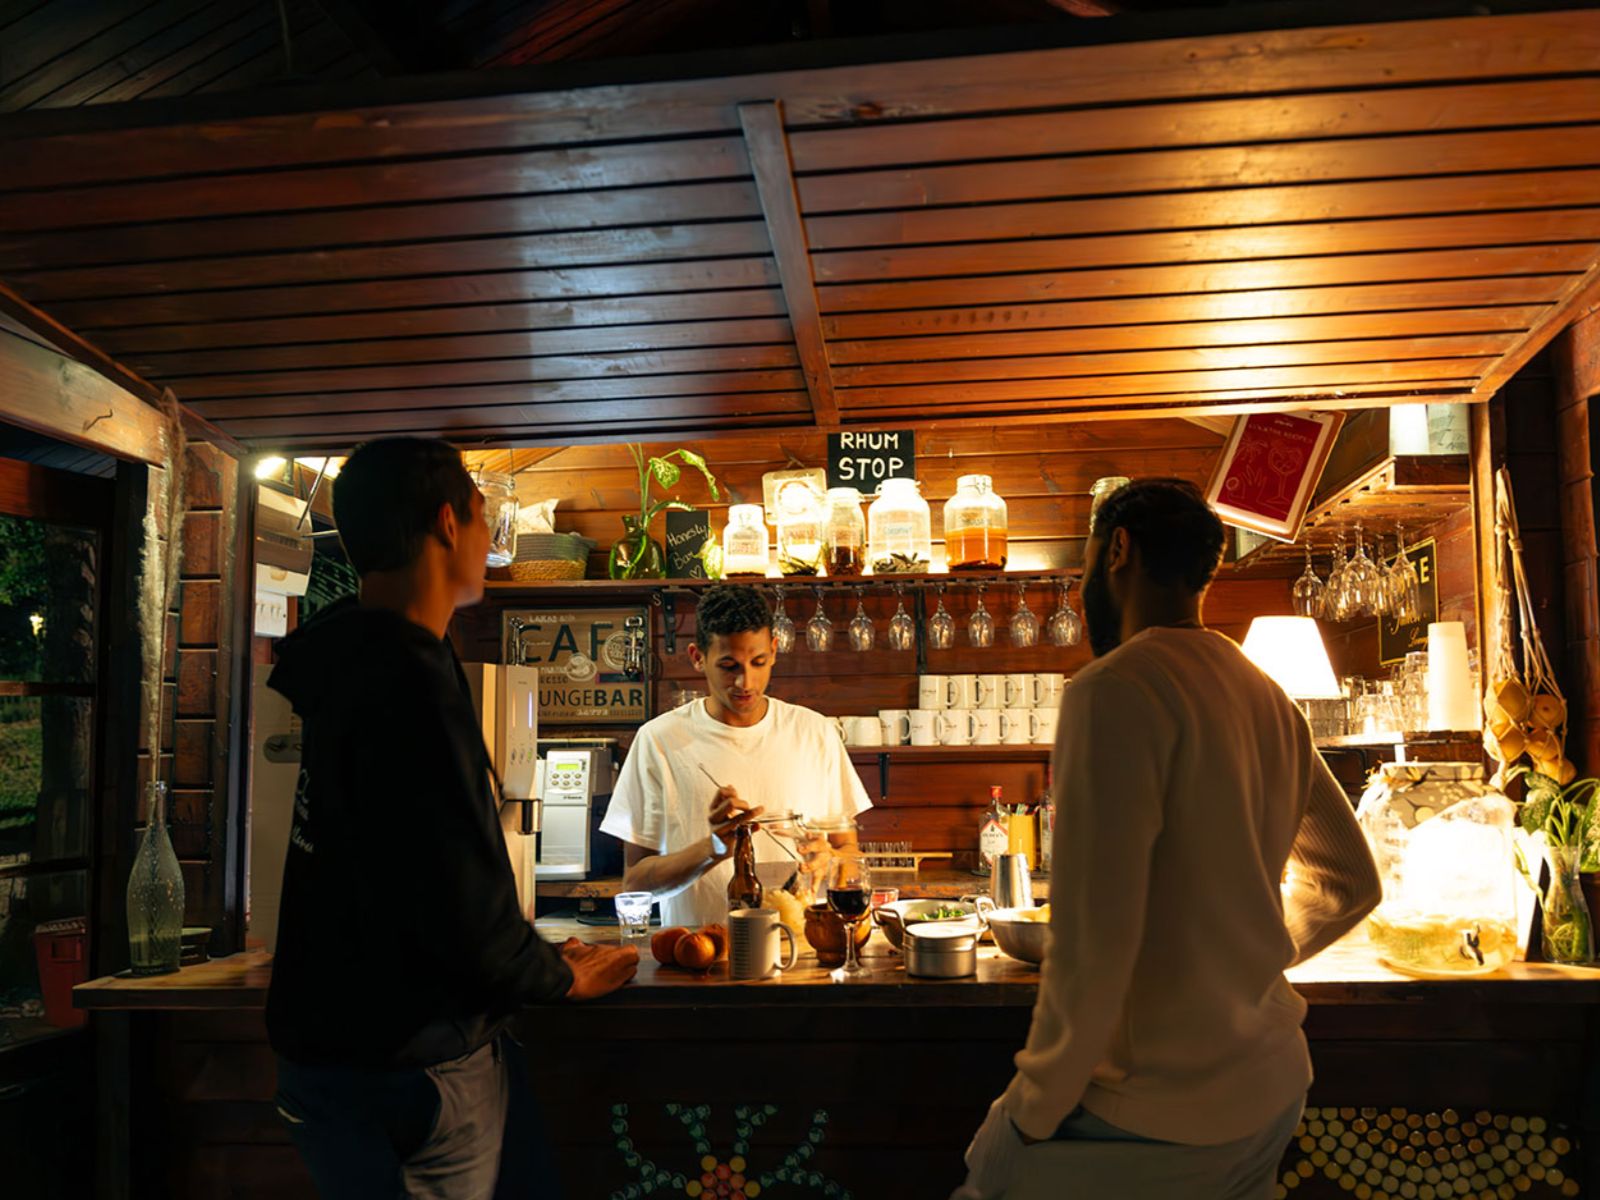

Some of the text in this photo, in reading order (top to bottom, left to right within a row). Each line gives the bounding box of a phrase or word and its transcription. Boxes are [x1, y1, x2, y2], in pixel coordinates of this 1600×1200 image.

[841, 431, 899, 450] RHUM
[839, 457, 904, 480] STOP
[518, 624, 614, 663] CAF
[539, 688, 643, 707] UNGEBAR
